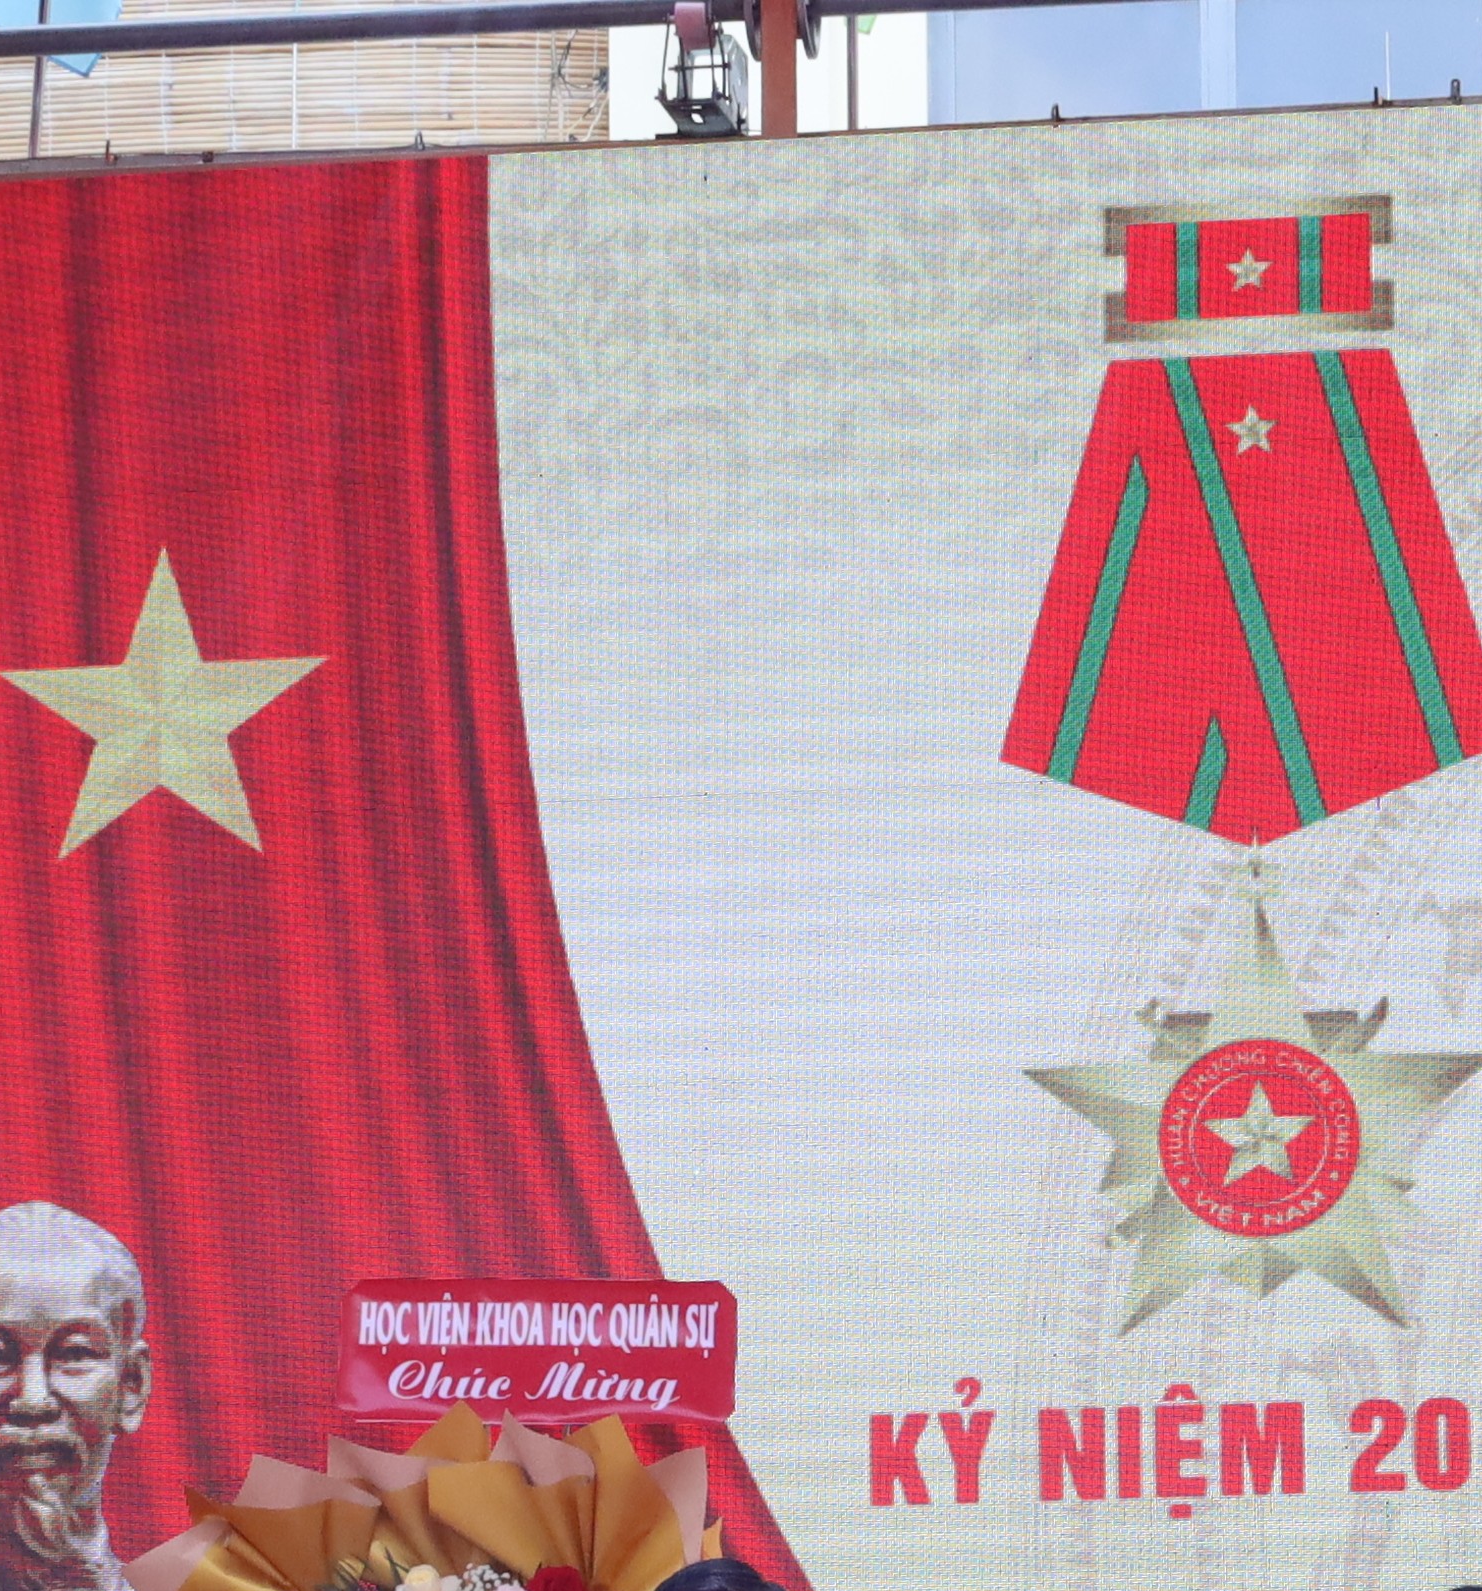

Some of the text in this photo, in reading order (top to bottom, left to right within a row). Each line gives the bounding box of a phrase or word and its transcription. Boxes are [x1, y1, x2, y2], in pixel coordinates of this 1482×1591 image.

[1263, 1189, 1326, 1227] NAM
[358, 1292, 720, 1358] HỌC VIỆN KHOA HỌC QUÂN SỰ
[386, 1359, 682, 1412] Chúc Mừng
[870, 1378, 994, 1506] KỶ
[1040, 1384, 1305, 1519] NIỆM
[1351, 1398, 1470, 1492] 20
